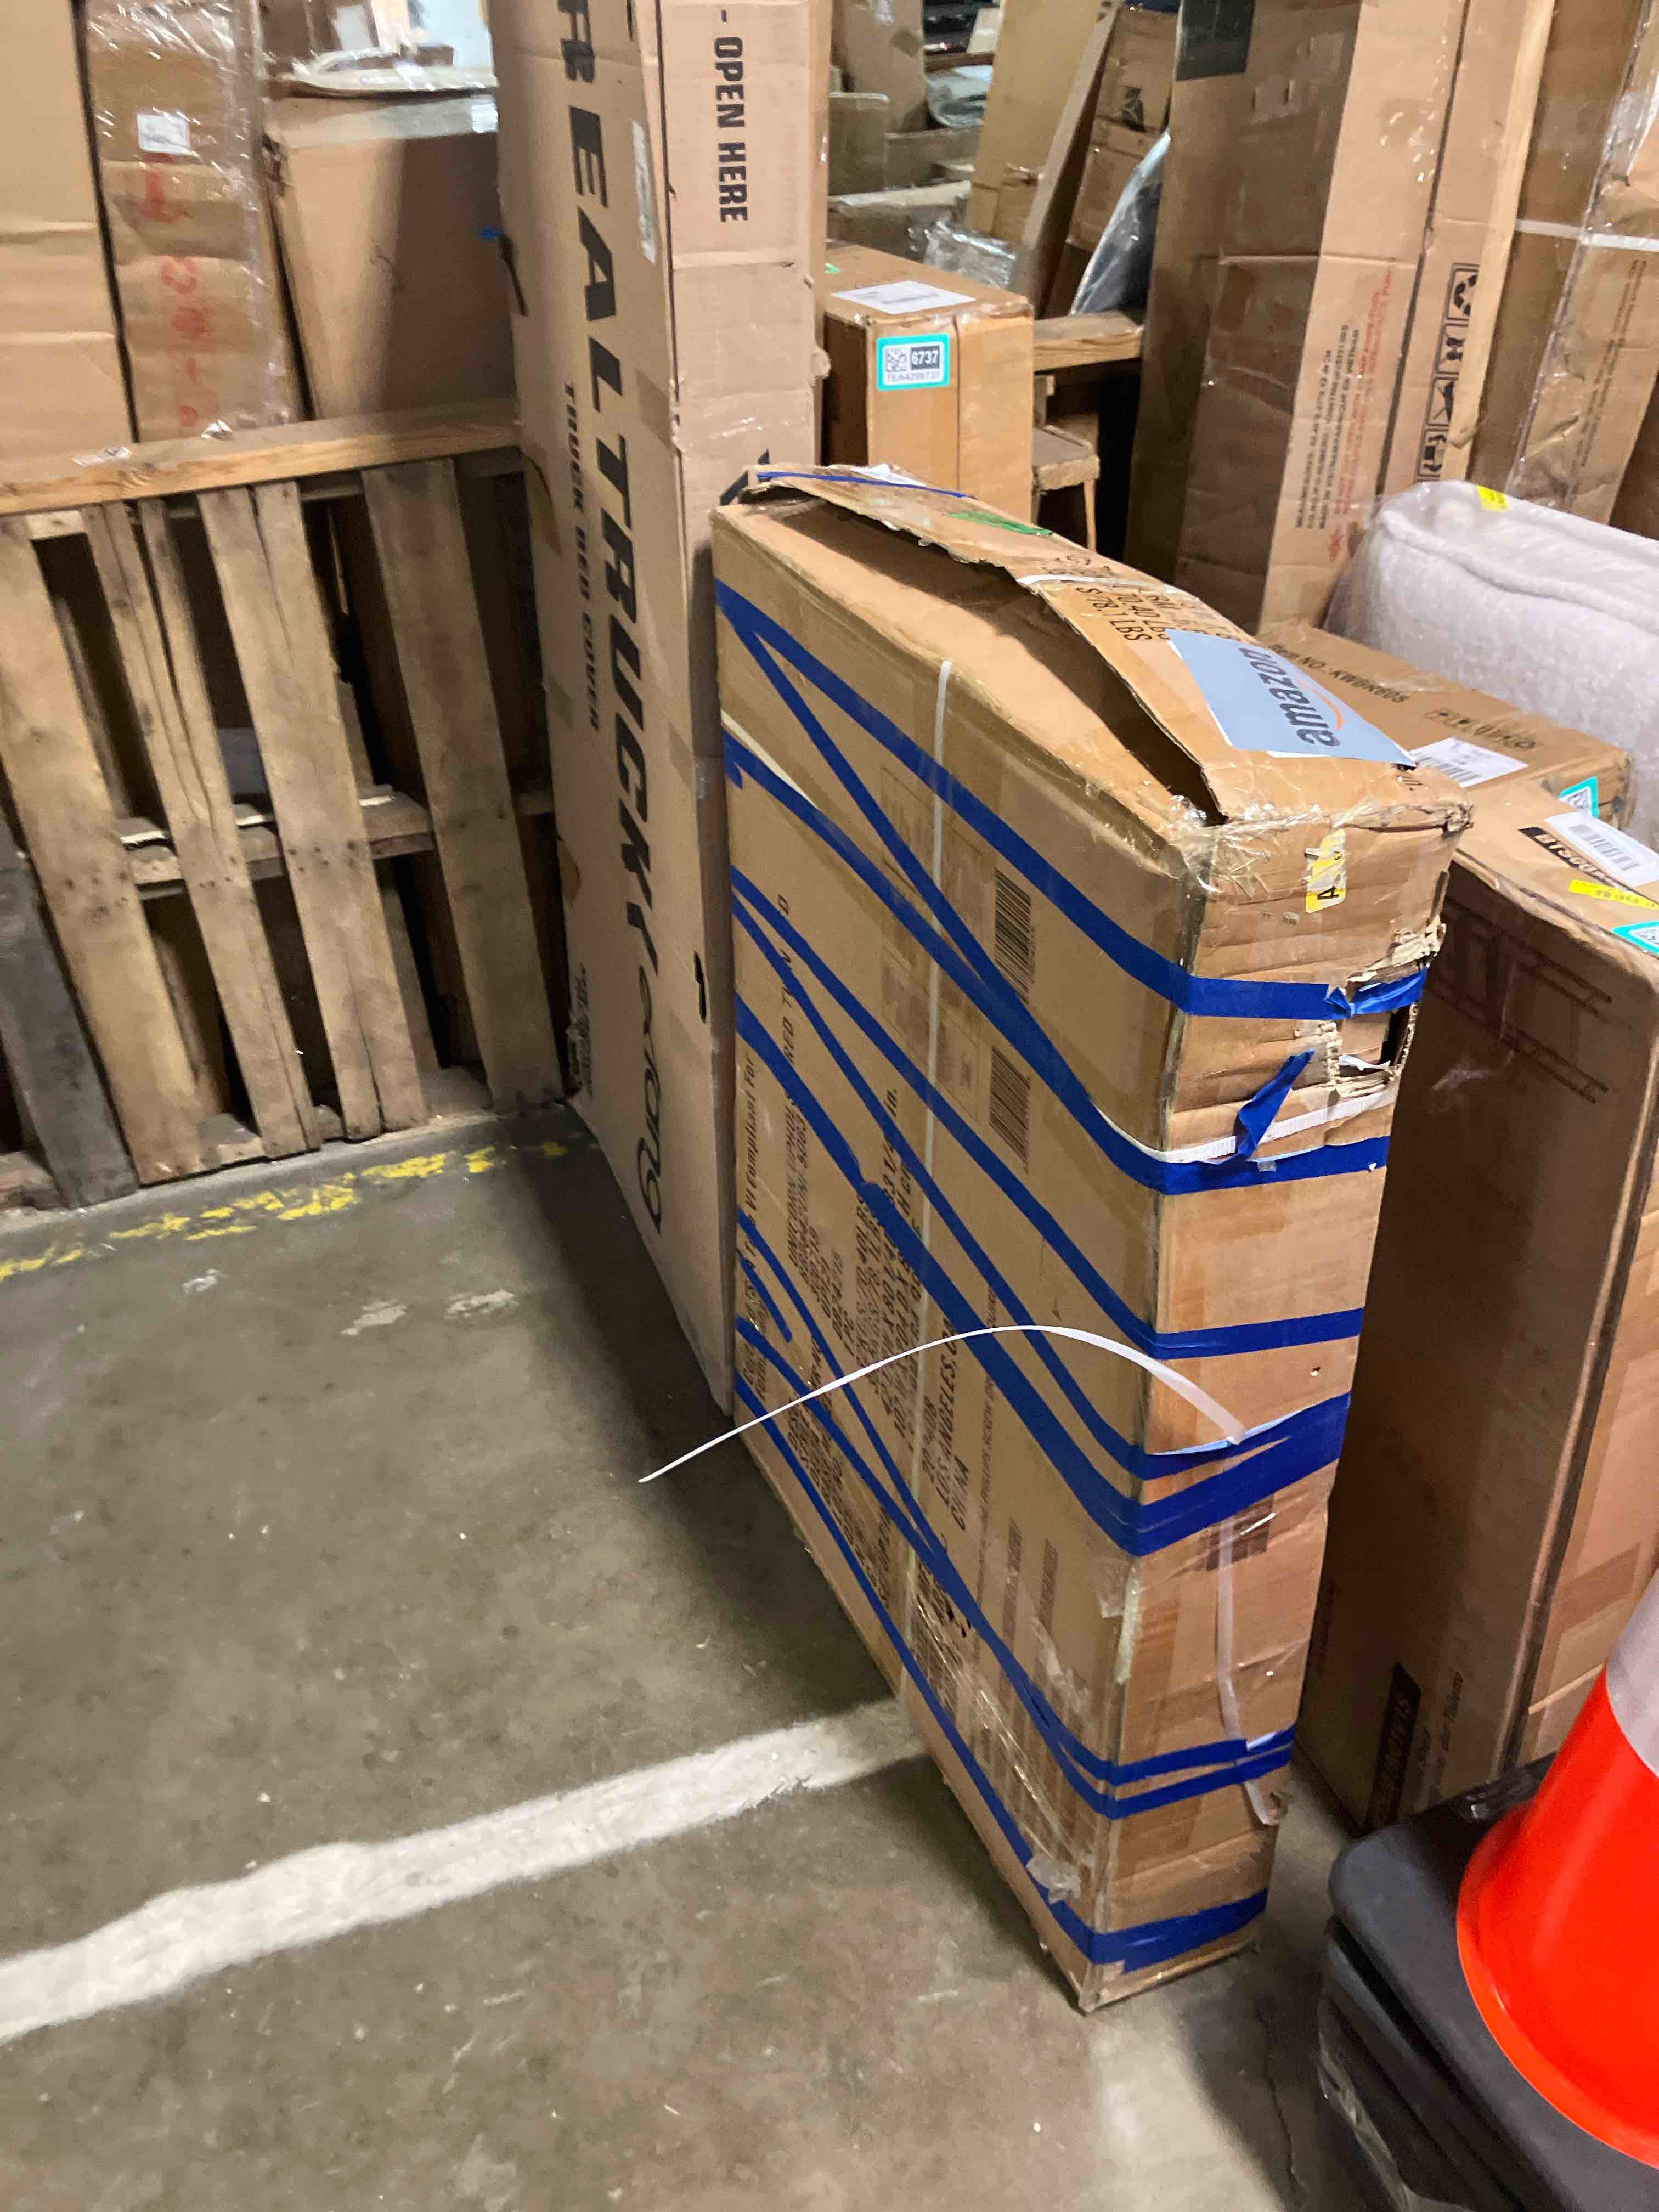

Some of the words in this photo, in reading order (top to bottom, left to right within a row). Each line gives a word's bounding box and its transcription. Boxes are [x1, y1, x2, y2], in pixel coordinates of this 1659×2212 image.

[714, 36, 747, 129] OPEN
[717, 142, 749, 223] HERE
[911, 351, 940, 365] 6737
[565, 383, 583, 513] TRUCK
[1238, 647, 1341, 747] amazon
[743, 1049, 755, 1092] For
[743, 1085, 758, 1196] Compliant
[744, 1182, 756, 1217] VI
[787, 1171, 797, 1269] UNICORN
[935, 1452, 951, 1511] LOS
[951, 1449, 969, 1537] CHINA
